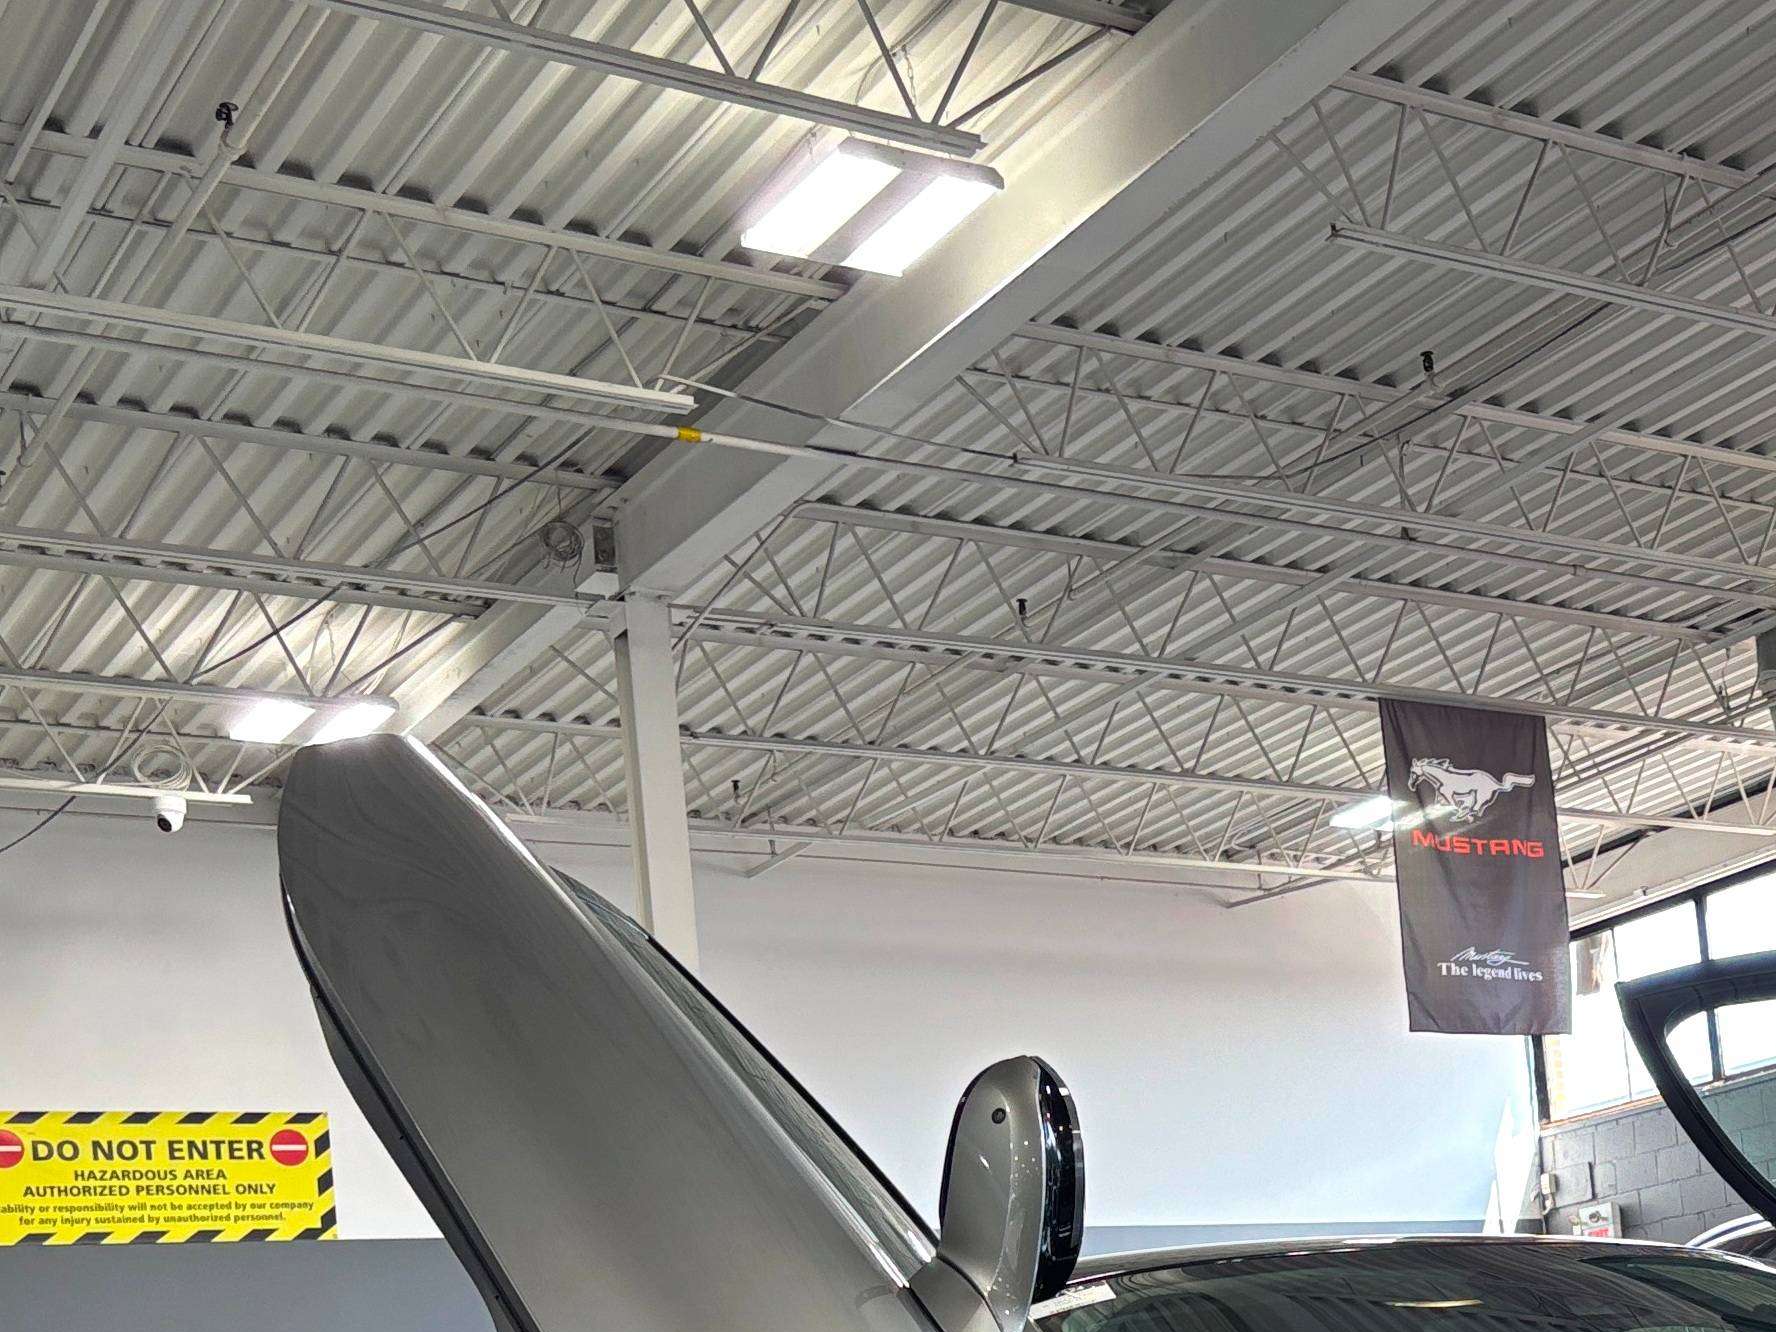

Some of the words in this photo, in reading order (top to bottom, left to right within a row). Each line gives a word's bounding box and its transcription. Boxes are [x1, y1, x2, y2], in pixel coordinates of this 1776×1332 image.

[1411, 828, 1545, 858] MUSTANG
[1437, 962, 1469, 976] The
[1472, 963, 1511, 981] legend
[1513, 967, 1544, 981] lives
[32, 1139, 80, 1162] DO
[92, 1139, 156, 1161] NOT
[168, 1139, 266, 1161] ENTER
[74, 1168, 178, 1182] HAZARDOUS
[183, 1168, 227, 1180] AREA
[23, 1184, 130, 1198] AUTHORIZED
[136, 1183, 230, 1197] PERSONNEL
[235, 1183, 277, 1195] ONLY
[53, 1203, 125, 1215] responsibility
[127, 1202, 147, 1211] will
[150, 1203, 167, 1211] not
[170, 1202, 184, 1211] be
[186, 1201, 232, 1211] accepted
[235, 1201, 248, 1211] by
[269, 1201, 314, 1211] company
[19, 1216, 36, 1225] for
[38, 1217, 57, 1226] any
[60, 1215, 92, 1226] injury
[95, 1214, 145, 1224] sustained
[147, 1214, 161, 1224] by
[163, 1213, 231, 1223] unauthorized
